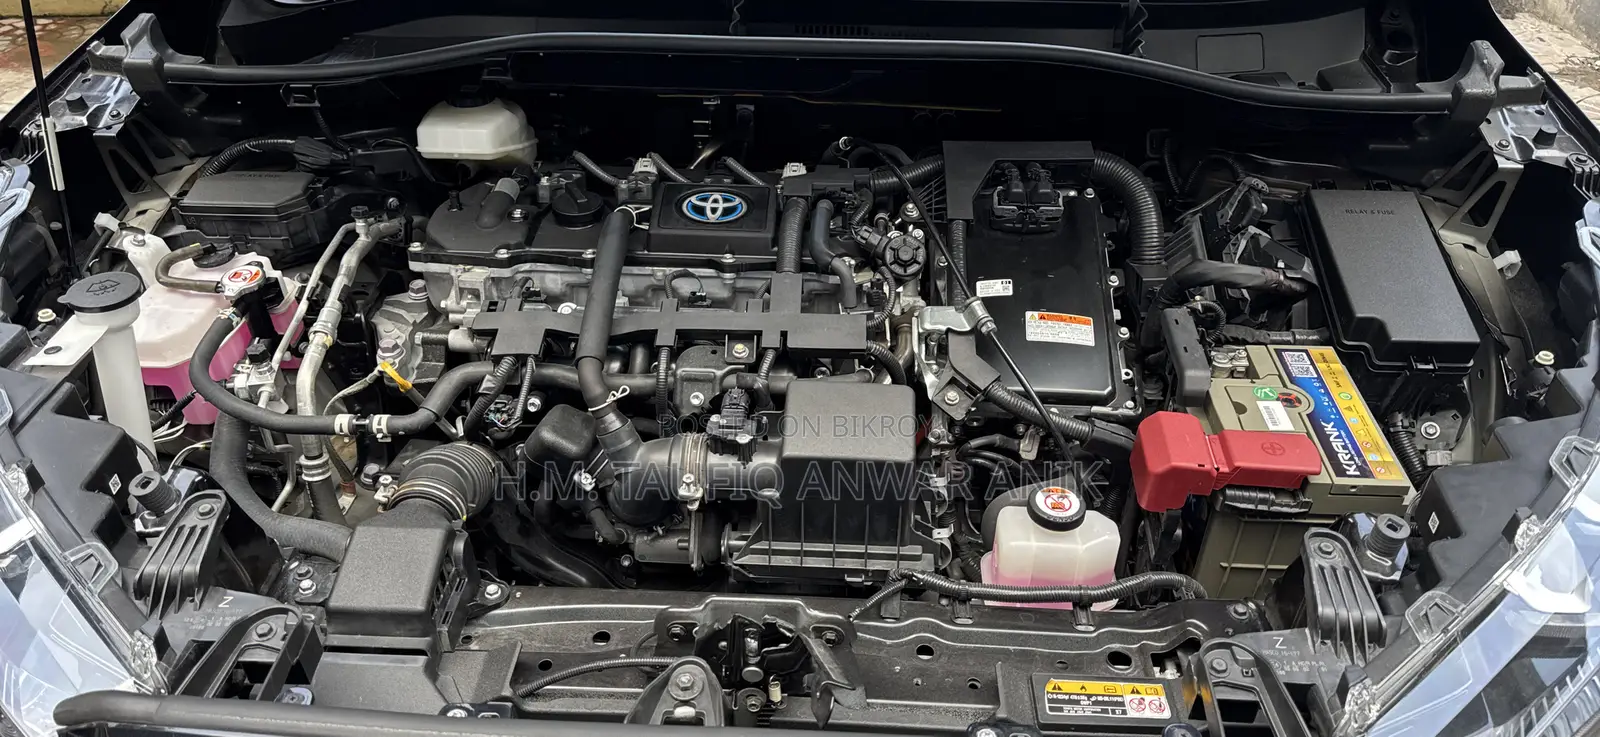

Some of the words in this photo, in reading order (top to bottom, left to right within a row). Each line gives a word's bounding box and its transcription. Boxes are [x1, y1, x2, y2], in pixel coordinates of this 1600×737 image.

[1321, 421, 1360, 475] KRANK
[218, 596, 234, 608] Z
[1273, 637, 1287, 649] Z
